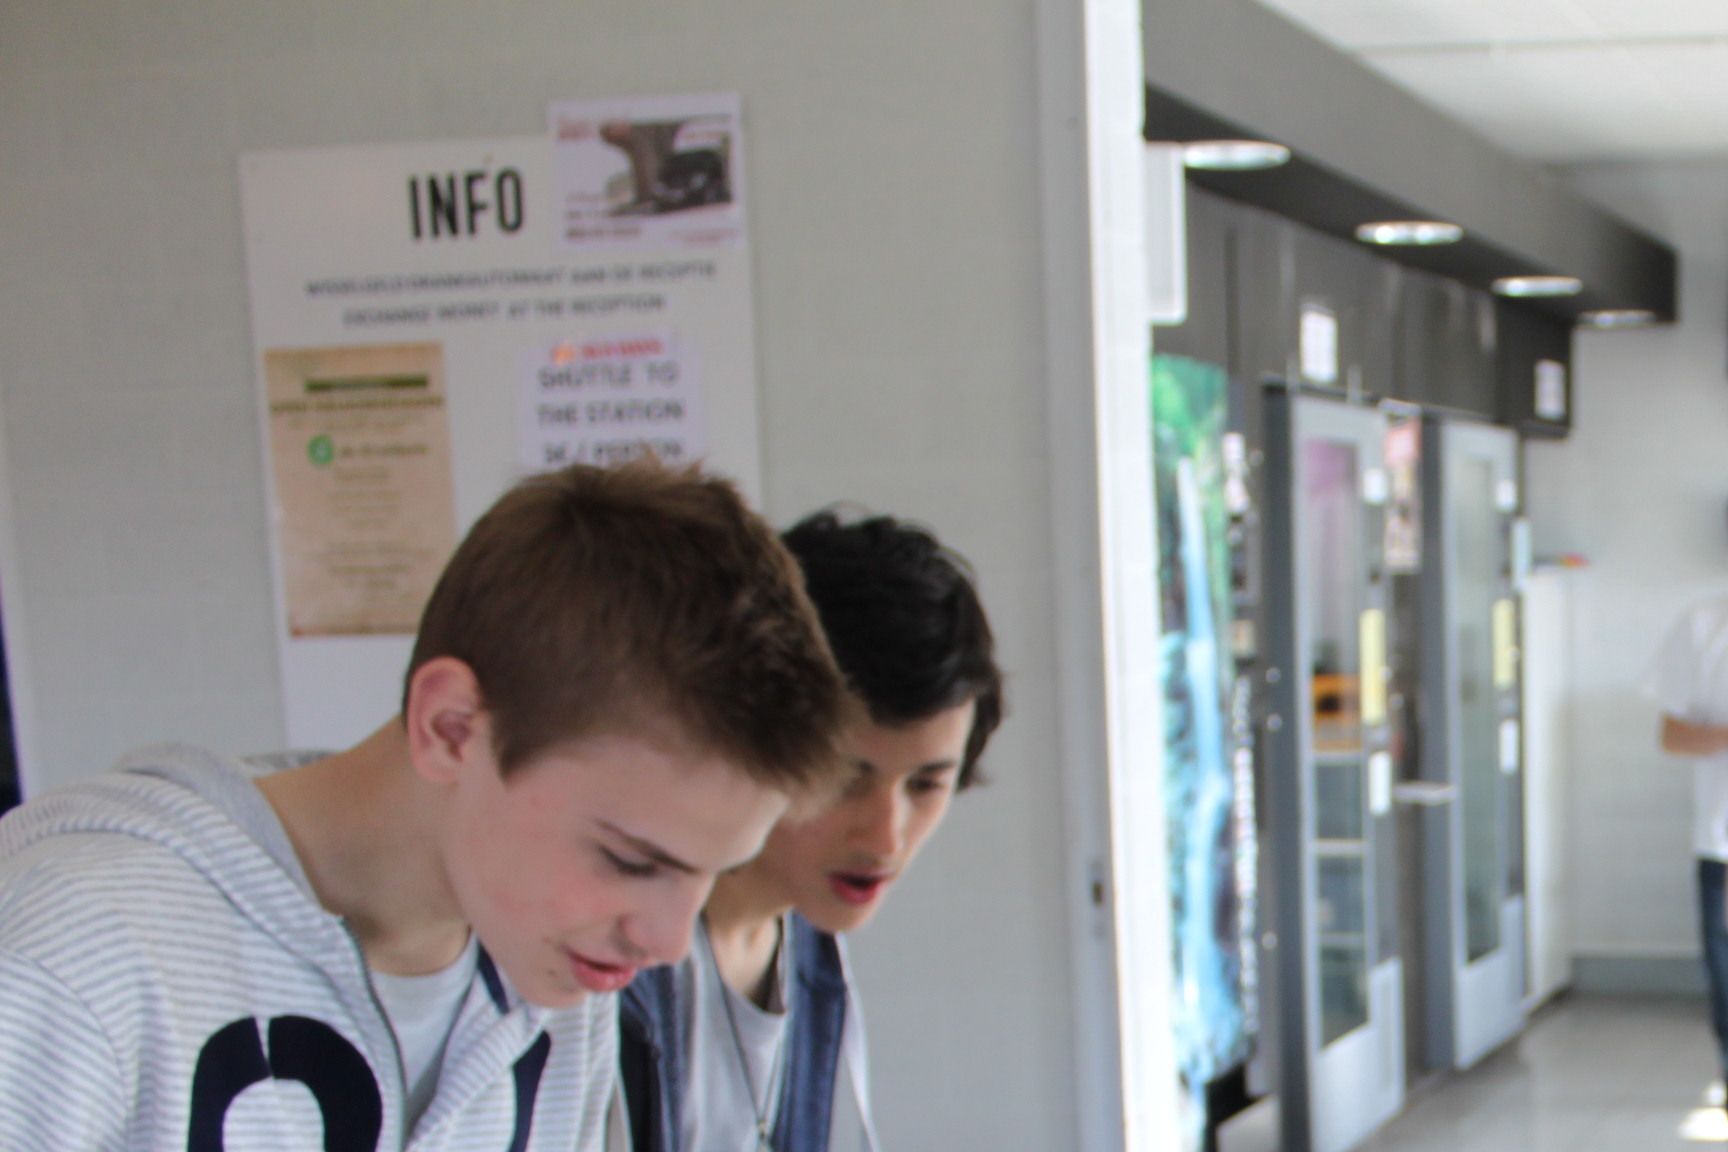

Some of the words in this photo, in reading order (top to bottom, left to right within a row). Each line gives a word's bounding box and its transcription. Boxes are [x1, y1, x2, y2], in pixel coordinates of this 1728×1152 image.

[408, 169, 524, 239] INFO
[537, 362, 631, 388] SHUTTLE
[646, 360, 681, 386] TO
[536, 401, 578, 427] THE
[586, 398, 685, 425] STATION
